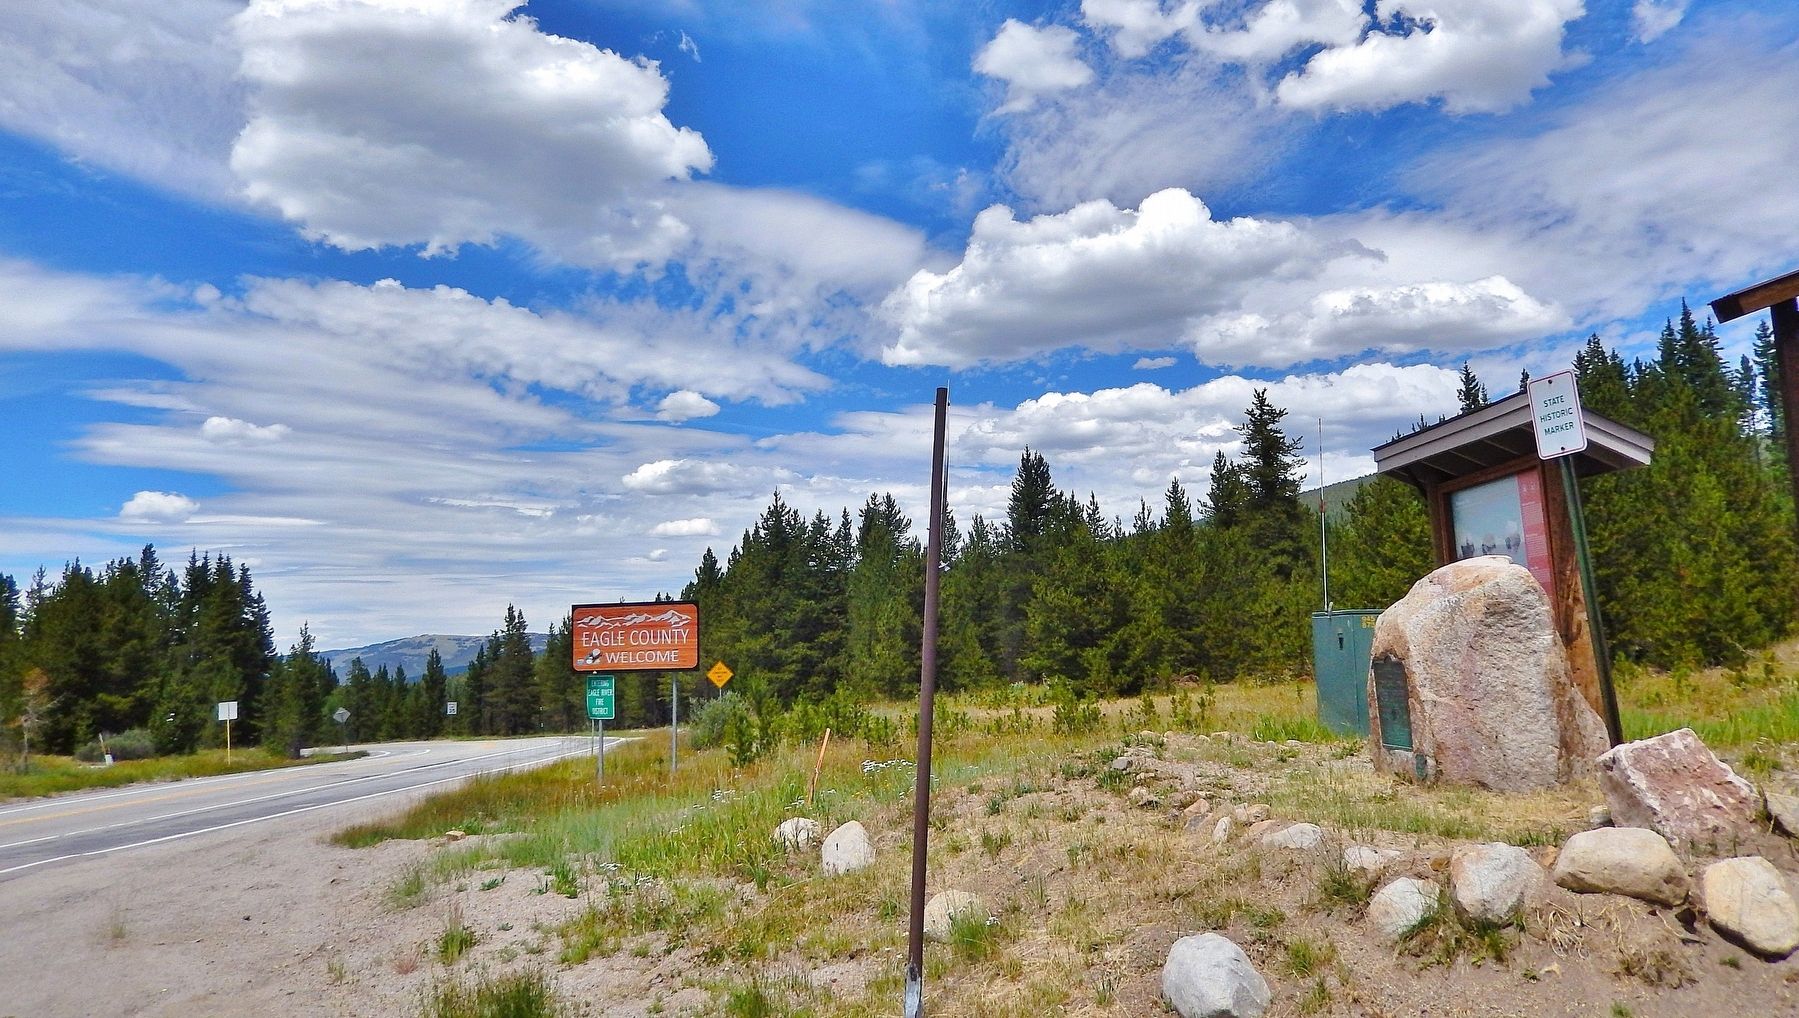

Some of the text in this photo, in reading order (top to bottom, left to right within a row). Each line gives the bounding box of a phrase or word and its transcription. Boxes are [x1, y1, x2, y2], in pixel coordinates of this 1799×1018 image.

[1543, 395, 1565, 408] STATE
[1540, 407, 1573, 423] HISTORIC
[1544, 421, 1574, 436] MARKER
[582, 629, 689, 647] EAGLE COUNTY
[605, 650, 680, 663] WELCOME
[595, 698, 604, 706] FIRE
